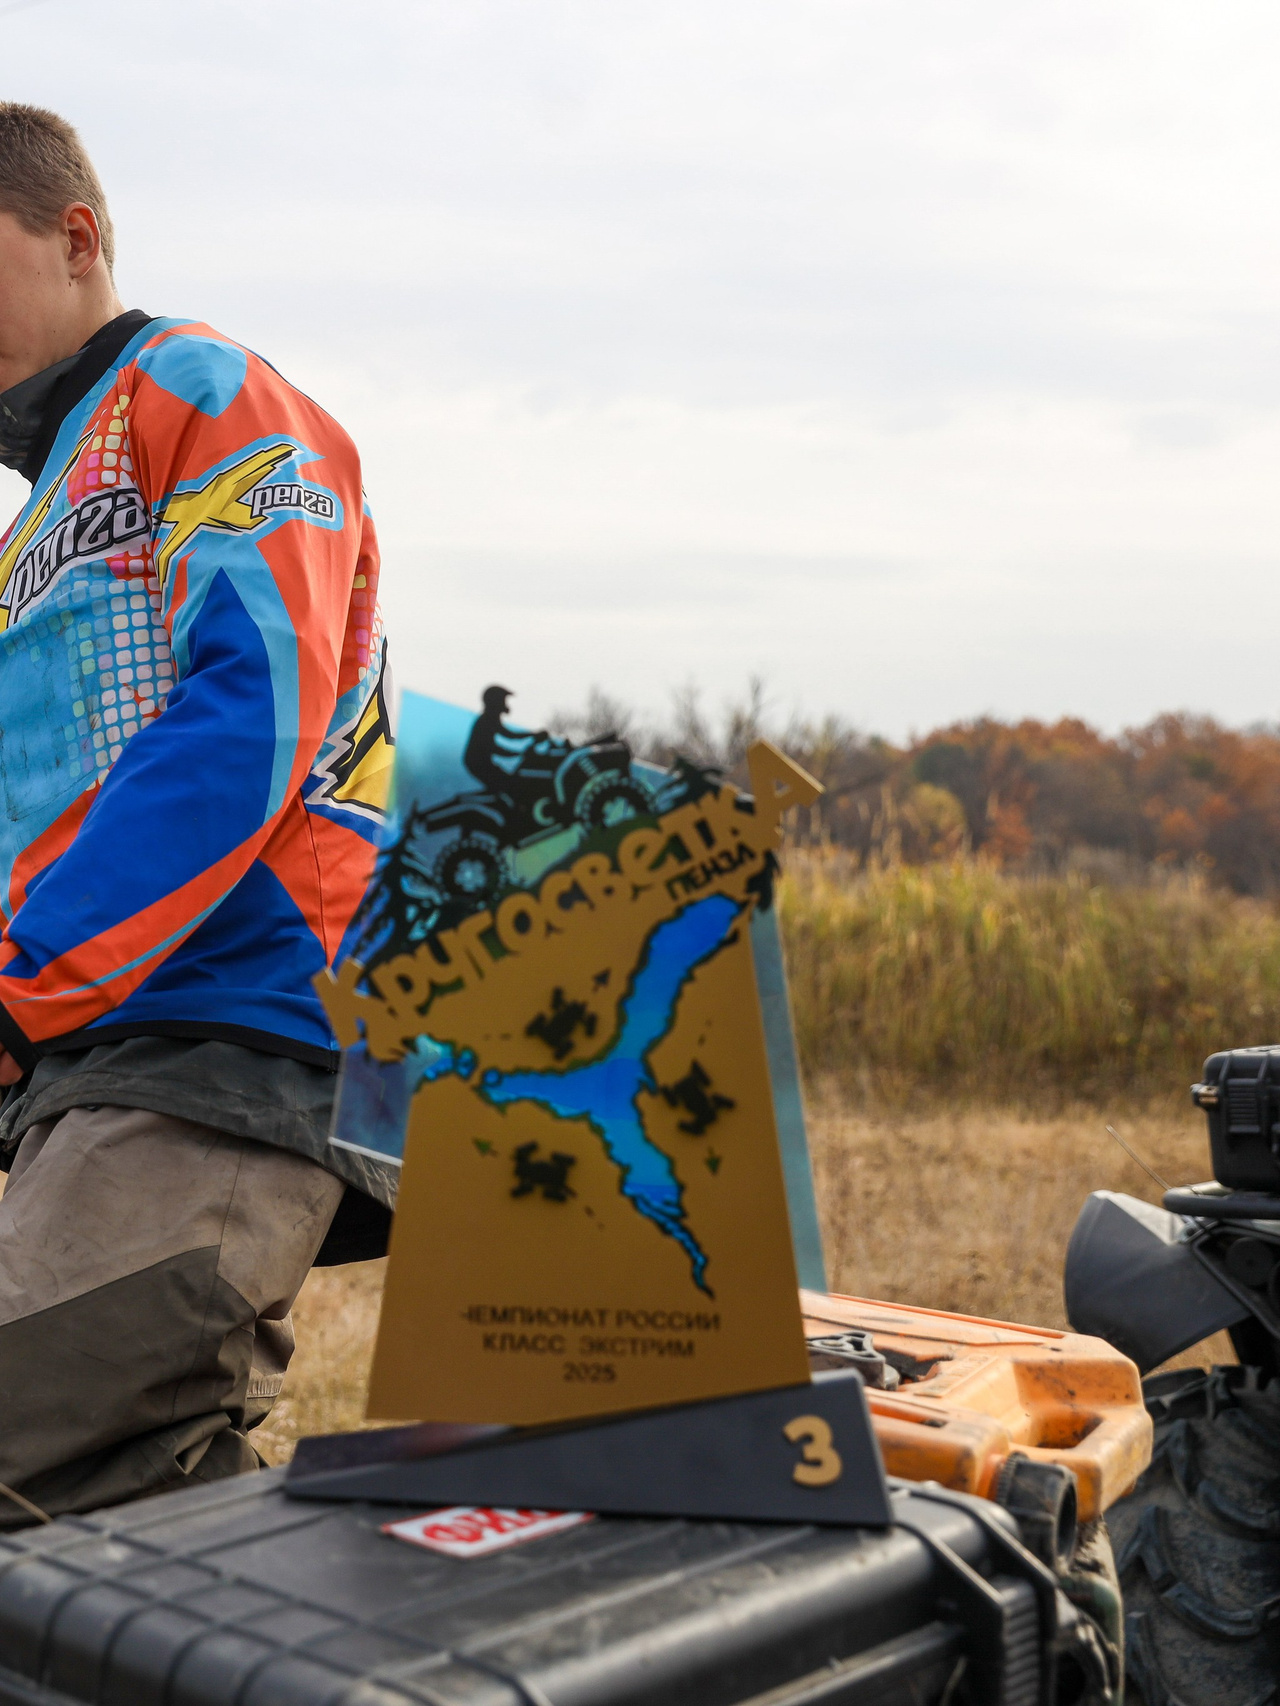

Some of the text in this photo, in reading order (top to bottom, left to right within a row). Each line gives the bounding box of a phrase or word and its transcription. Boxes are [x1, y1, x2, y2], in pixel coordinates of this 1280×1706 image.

[461, 1305, 721, 1332] ЧЕМПИОНАТ РОССИИ
[482, 1332, 695, 1357] КЛАСС ЭКСТРИМ
[563, 1362, 616, 1383] 2025
[783, 1414, 842, 1486] 3
